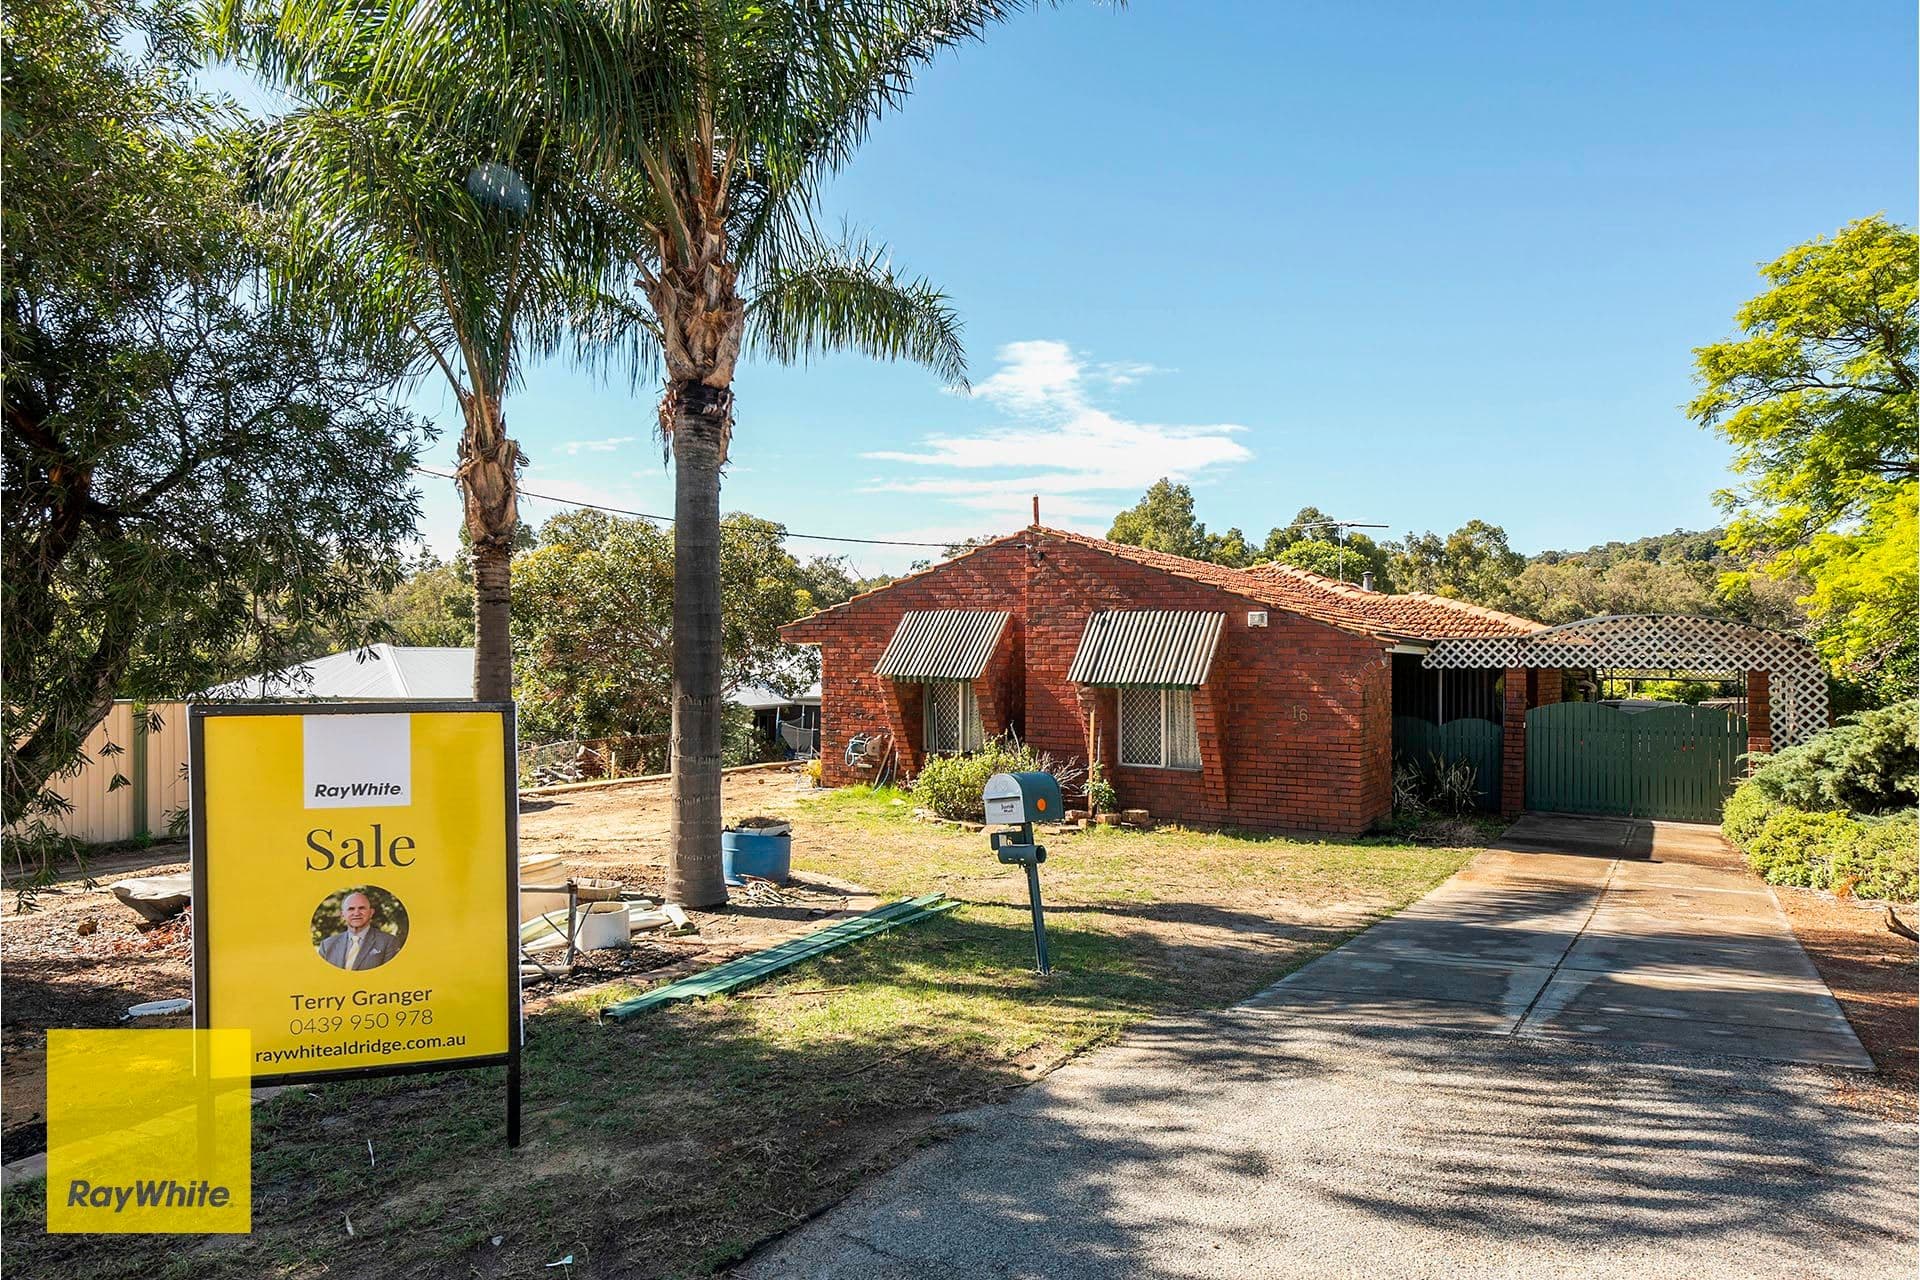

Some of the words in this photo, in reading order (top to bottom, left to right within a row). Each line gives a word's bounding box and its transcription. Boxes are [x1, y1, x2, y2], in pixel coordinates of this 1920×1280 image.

[1292, 705, 1309, 722] 16
[305, 823, 416, 871] Sale
[290, 994, 345, 1011] Terry
[352, 989, 432, 1006] Granger
[290, 1016, 343, 1036] 0439
[350, 1012, 389, 1031] 950
[395, 1008, 433, 1027] 978
[255, 1033, 466, 1064] raywhitealdridge.com.au
